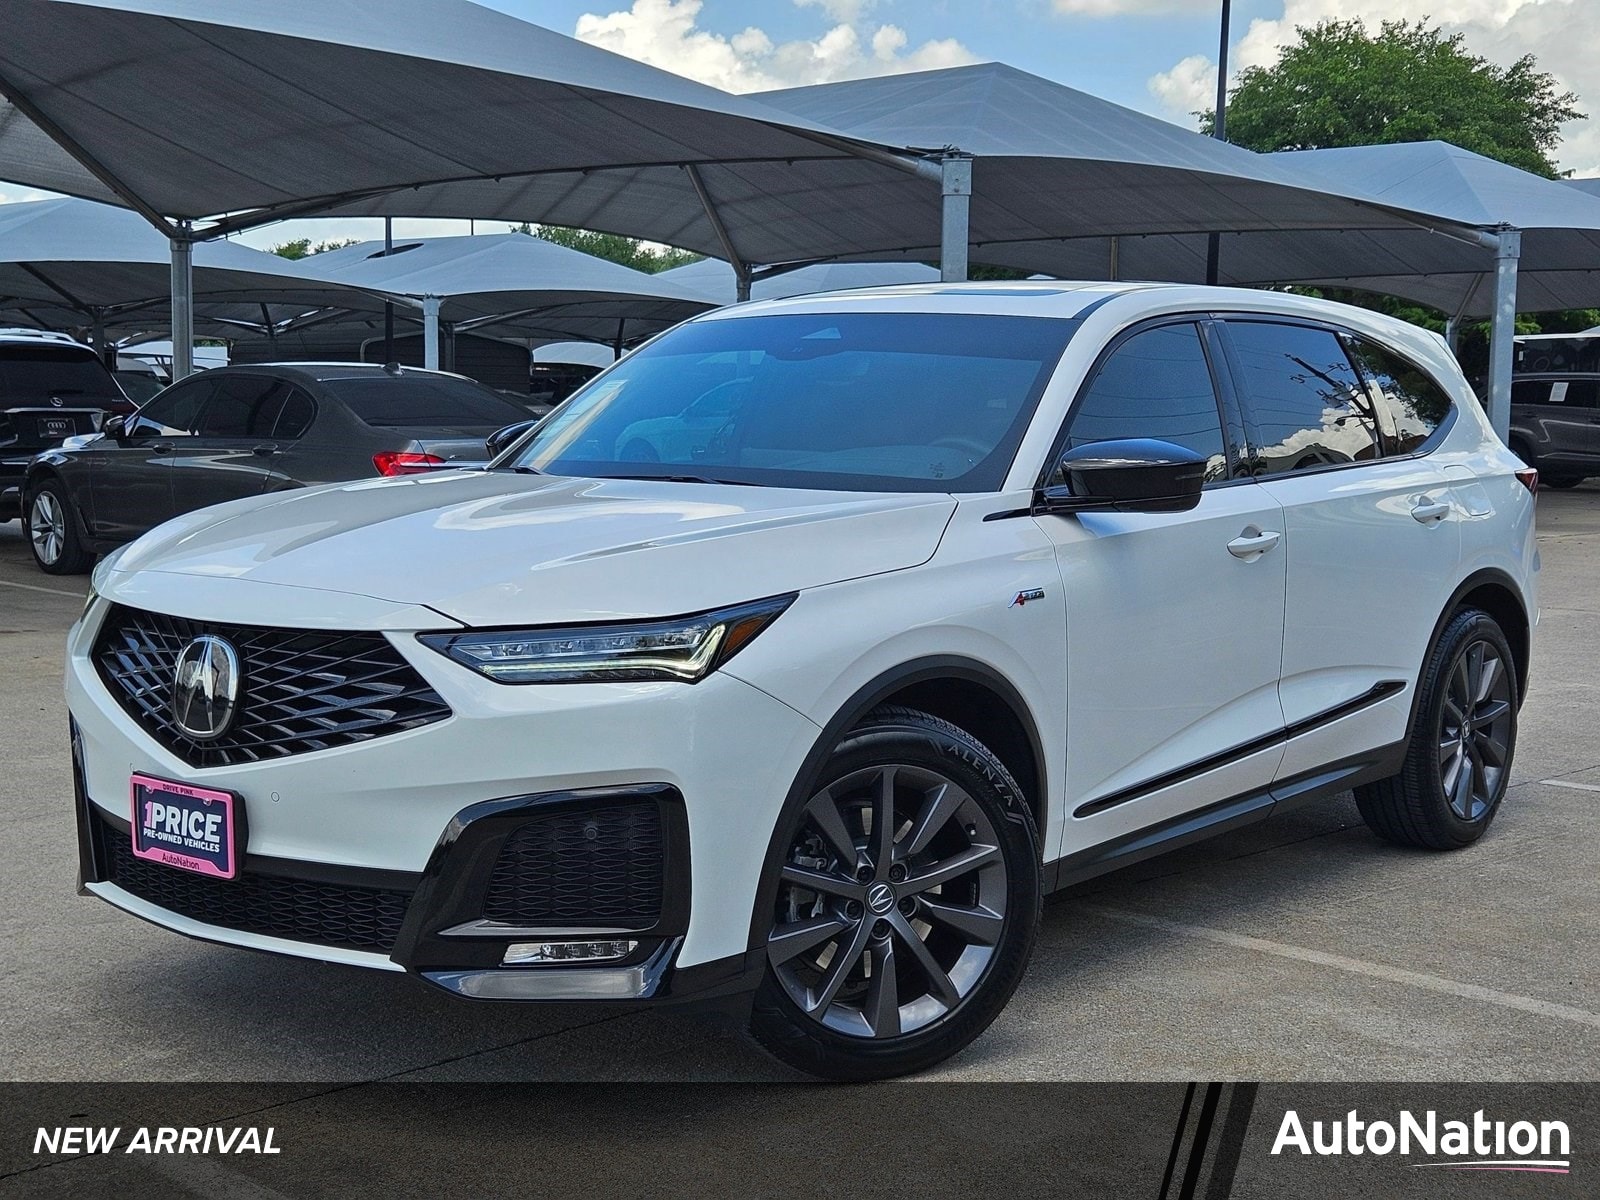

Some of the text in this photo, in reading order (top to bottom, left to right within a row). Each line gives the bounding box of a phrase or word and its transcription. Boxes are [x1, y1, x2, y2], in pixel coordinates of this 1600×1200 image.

[948, 743, 1014, 807] ALENZA
[144, 800, 222, 843] 1PRICE
[143, 827, 220, 853] PRE-OWNED VEHICLES
[161, 853, 200, 870] AutoNation
